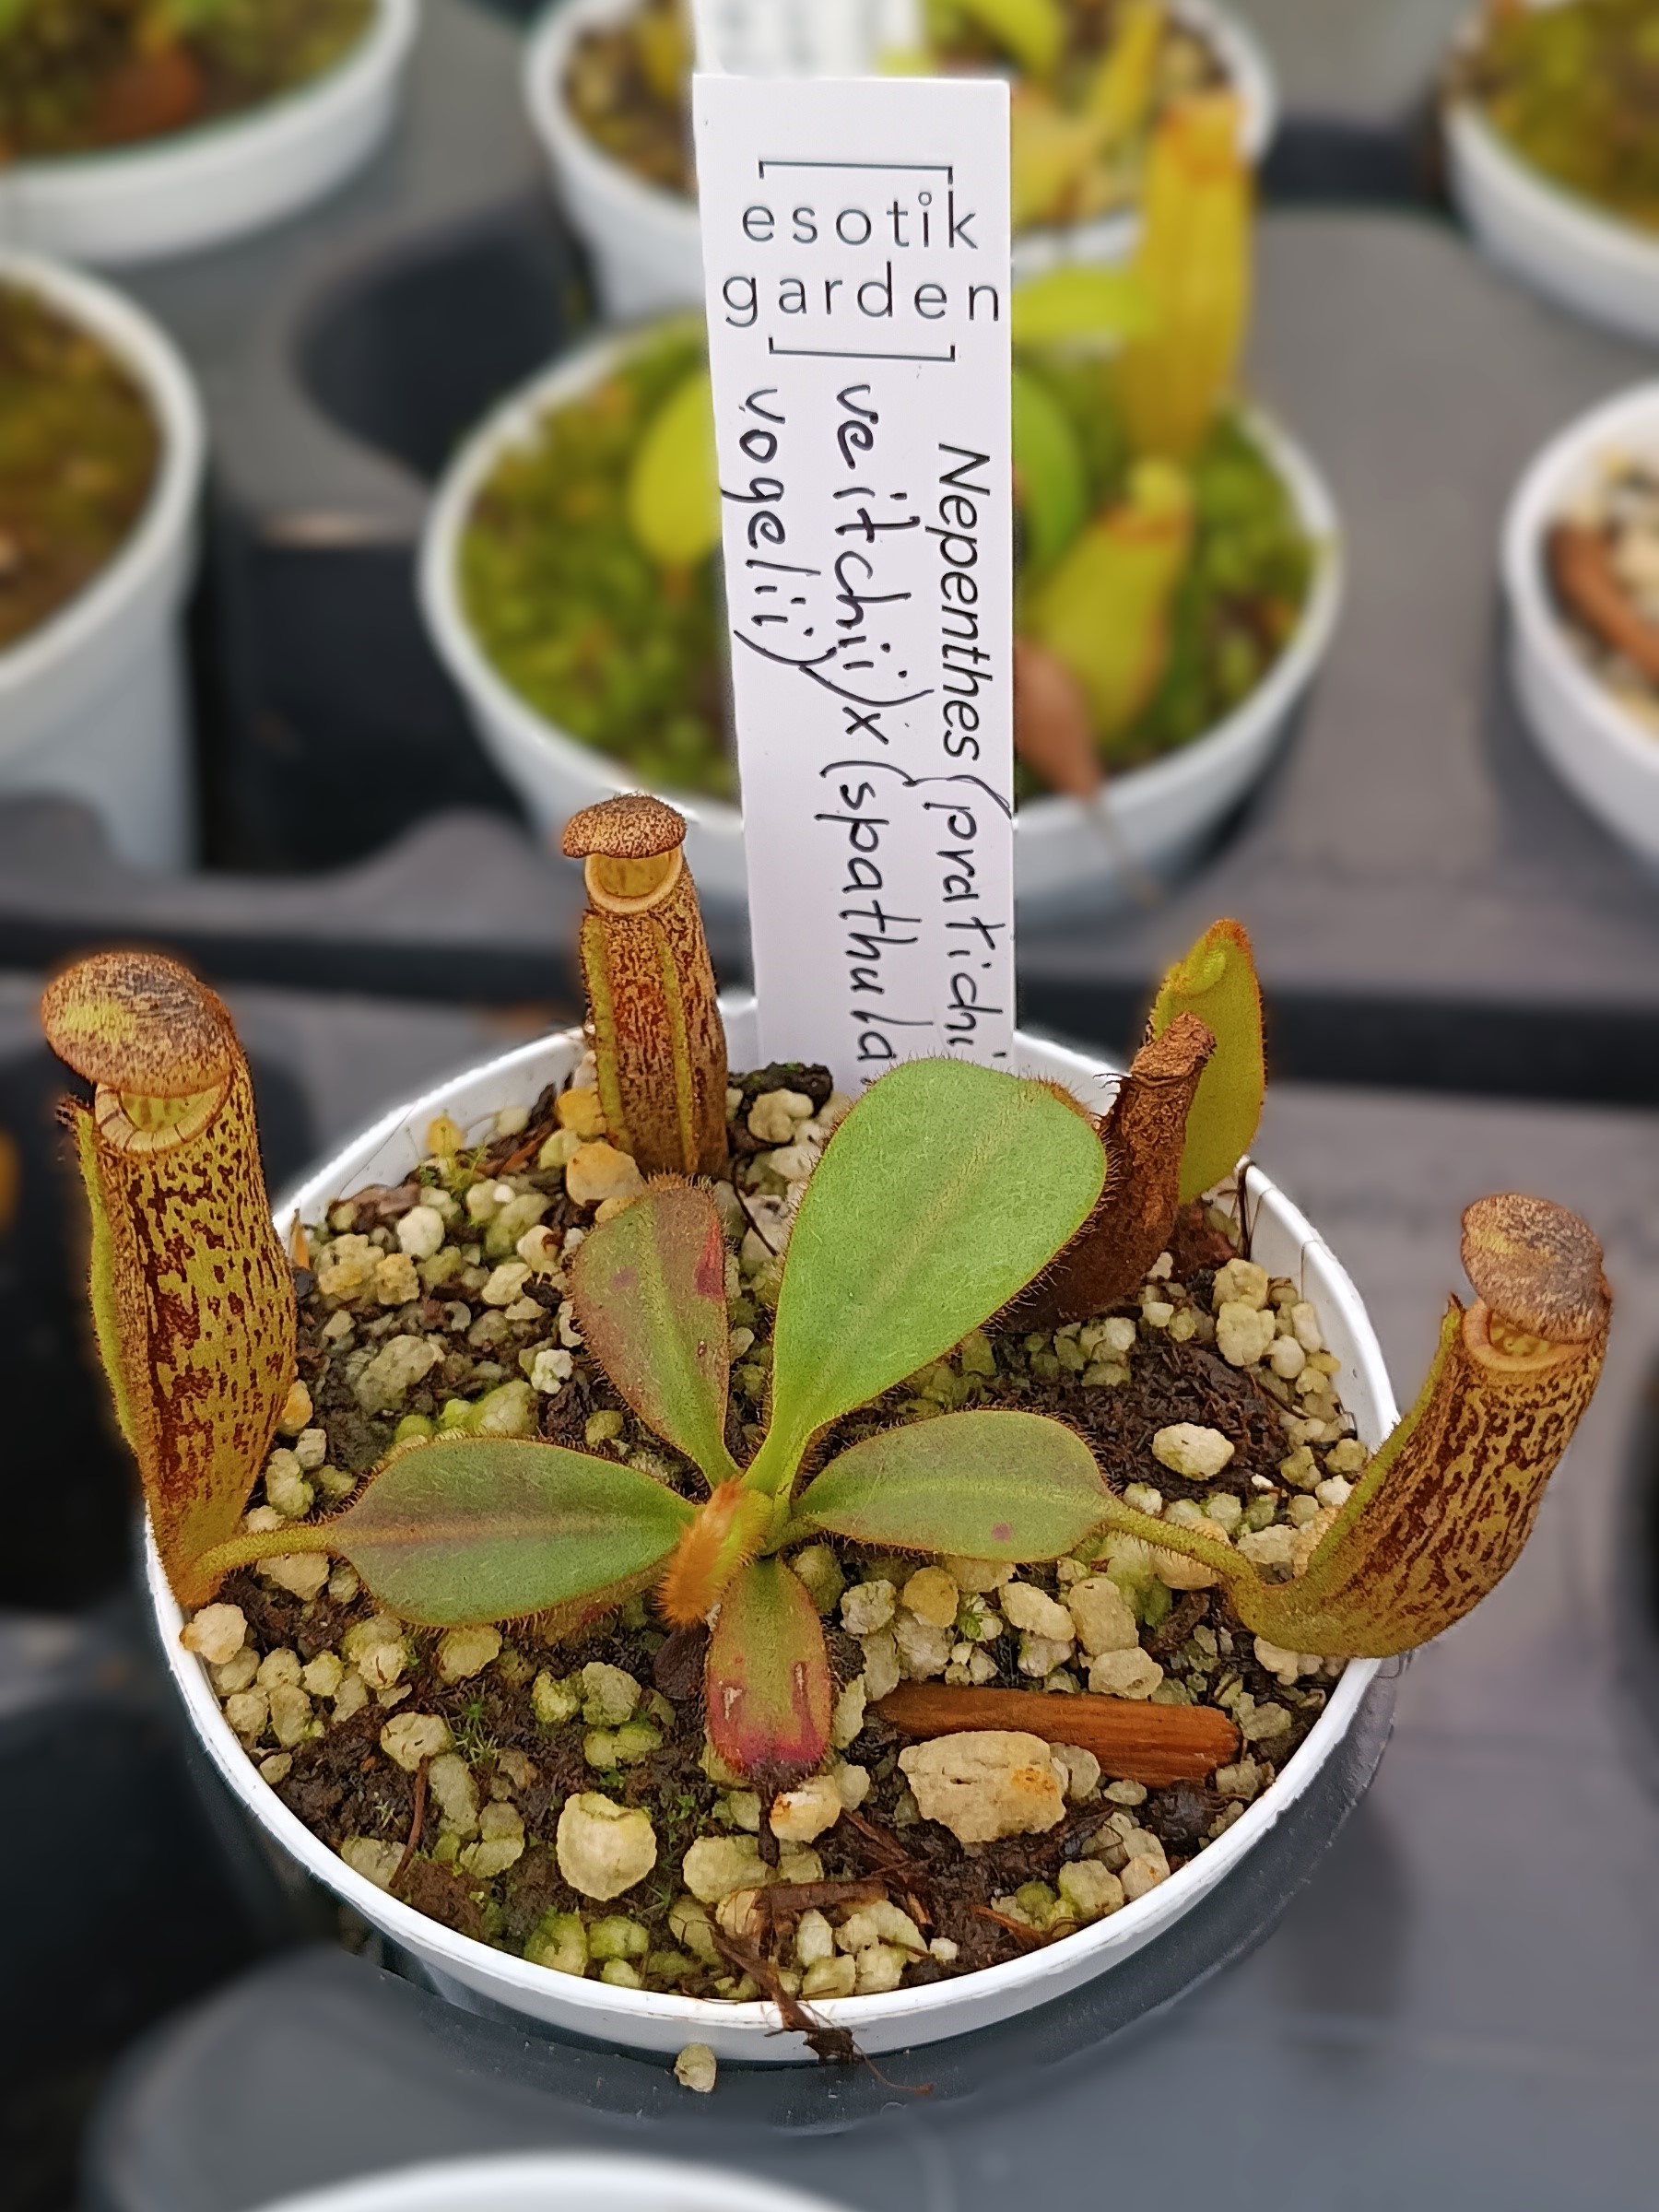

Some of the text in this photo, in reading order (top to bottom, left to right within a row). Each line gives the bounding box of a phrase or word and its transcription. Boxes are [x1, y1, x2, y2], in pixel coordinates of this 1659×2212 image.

[741, 191, 979, 250] esotik
[722, 260, 1000, 328] garden
[924, 442, 994, 761] Nepenthes
